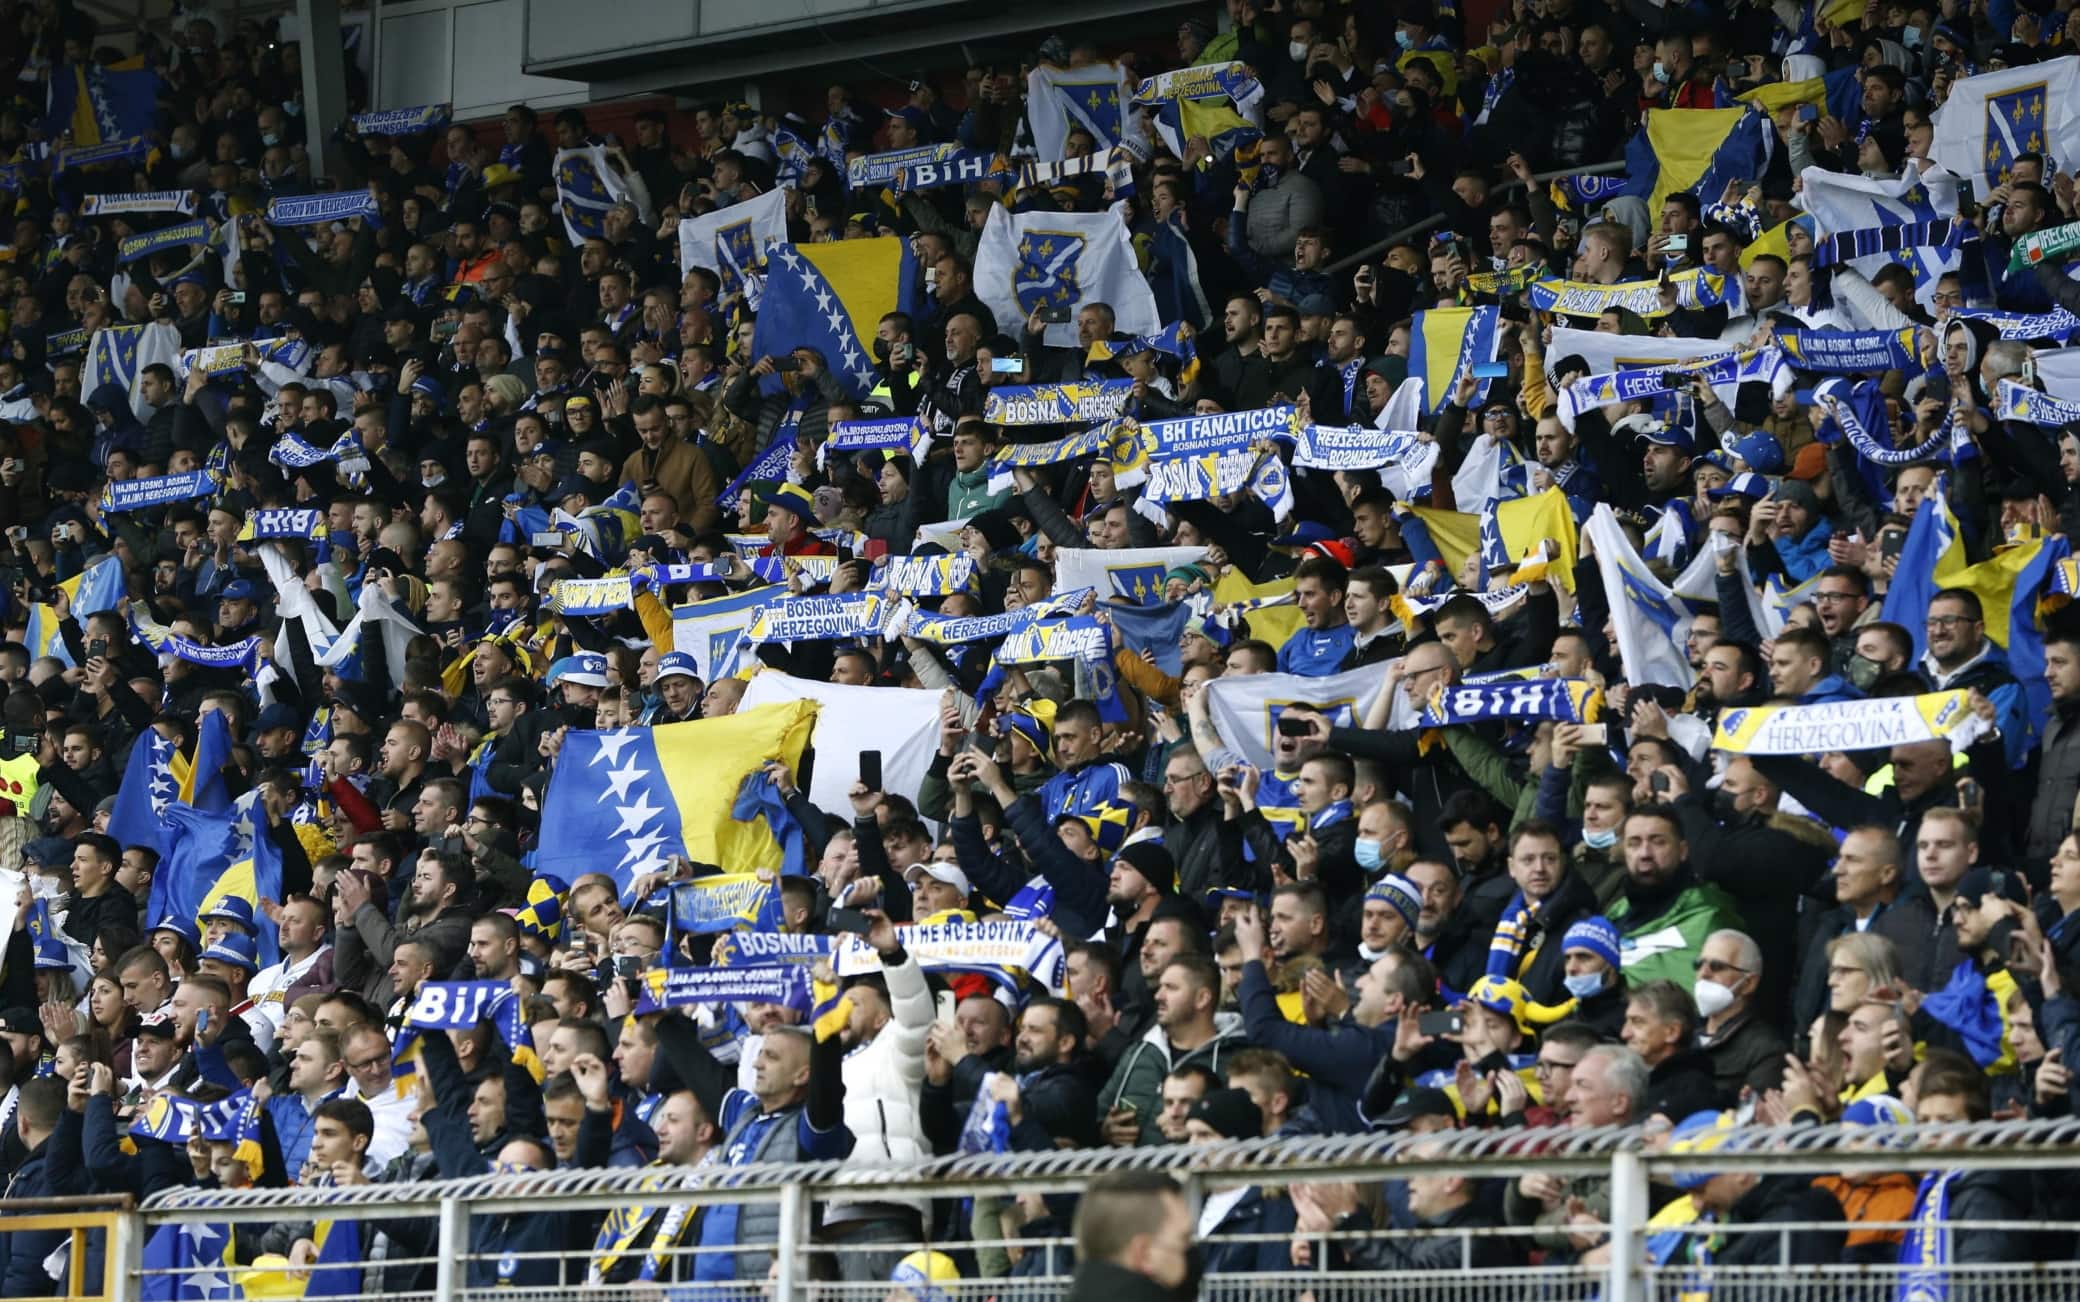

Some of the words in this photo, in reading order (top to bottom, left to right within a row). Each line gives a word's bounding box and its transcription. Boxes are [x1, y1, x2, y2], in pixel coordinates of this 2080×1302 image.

[915, 156, 983, 186] BiH
[1005, 397, 1060, 422] BOSNA
[1163, 422, 1186, 443] BH
[1191, 406, 1288, 439] FANATICOS
[1173, 439, 1210, 452] BOSNIAN
[1210, 433, 1249, 447] SUPPORT
[1252, 428, 1276, 441] ARMY
[116, 481, 140, 495] HAJMO
[144, 485, 194, 500] HERCEGOVINO
[786, 598, 845, 618] BOSNIA&
[771, 614, 862, 637] HERZEGOVINA
[1453, 684, 1545, 717] BiH
[1767, 720, 1908, 752] HERZEGOVINA
[735, 931, 818, 957] BOSNIA
[920, 919, 1036, 945] HERCEGOVINA
